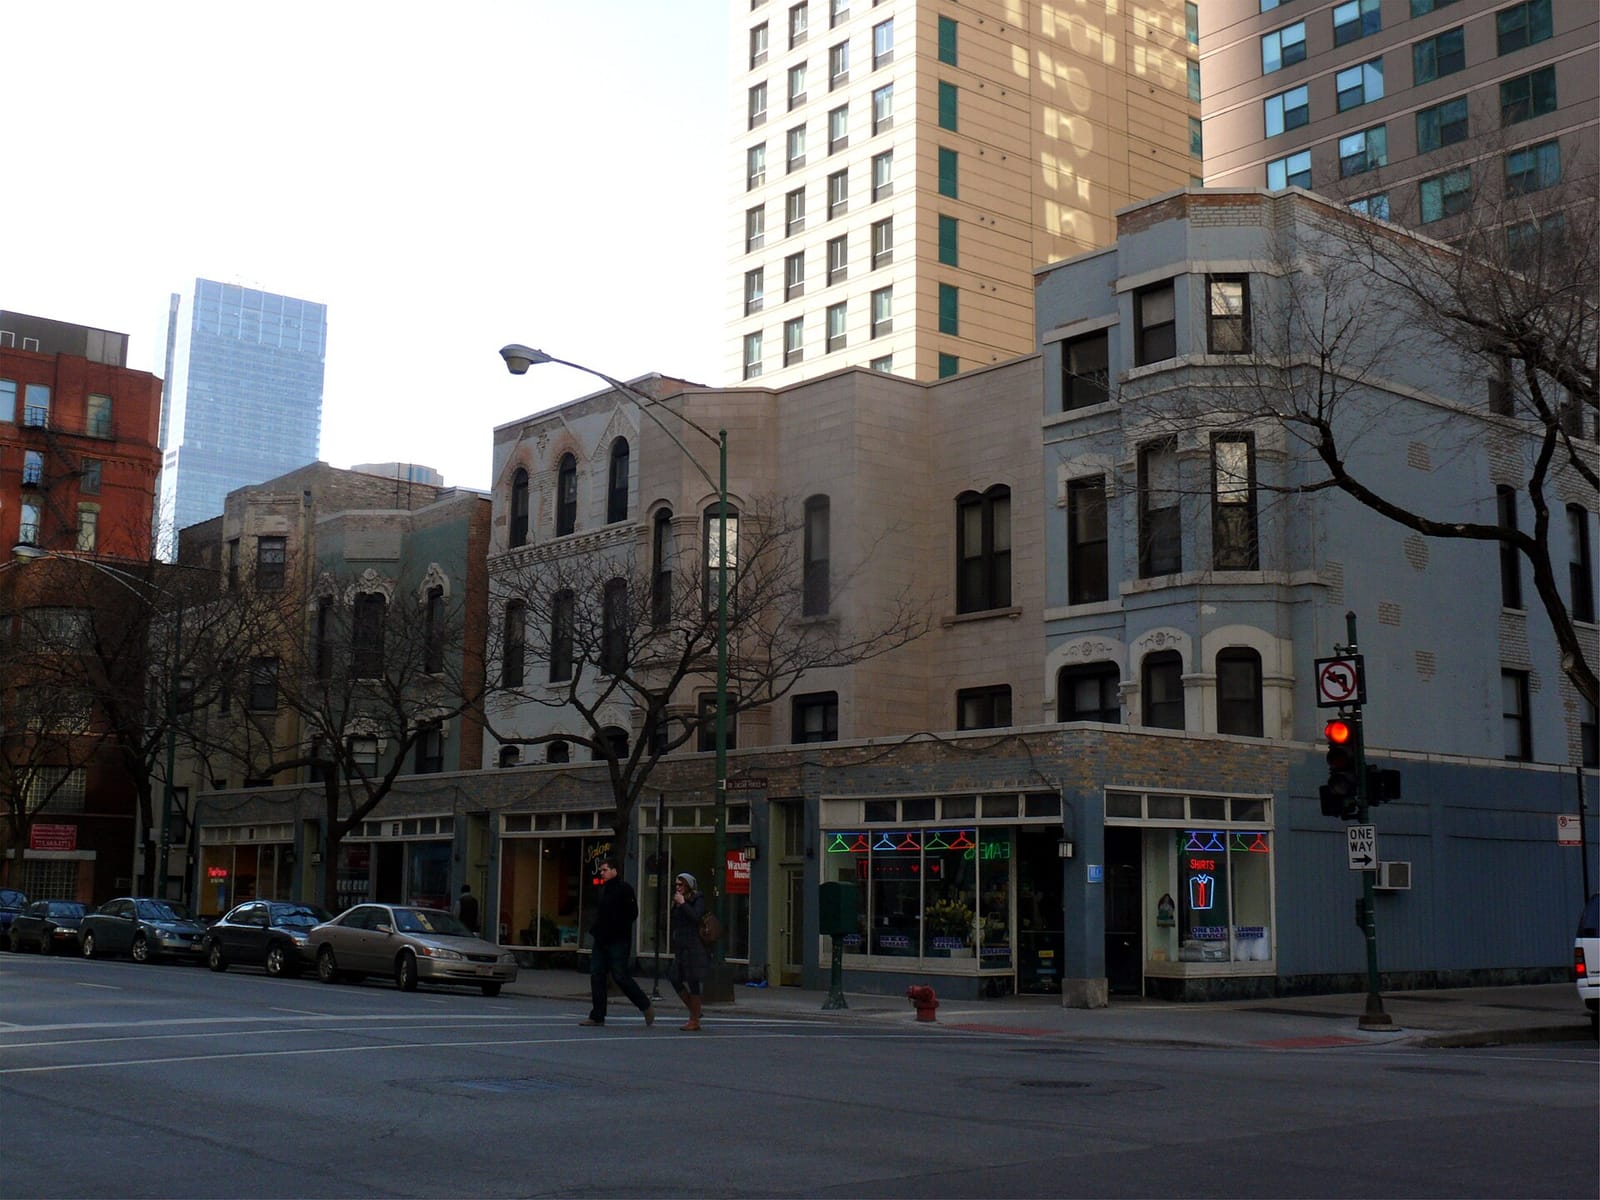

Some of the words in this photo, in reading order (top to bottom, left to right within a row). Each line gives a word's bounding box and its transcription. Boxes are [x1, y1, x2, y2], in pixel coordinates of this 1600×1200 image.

[1350, 828, 1373, 839] ONE
[1350, 841, 1373, 852] WAY
[1189, 858, 1215, 871] SHIRTS
